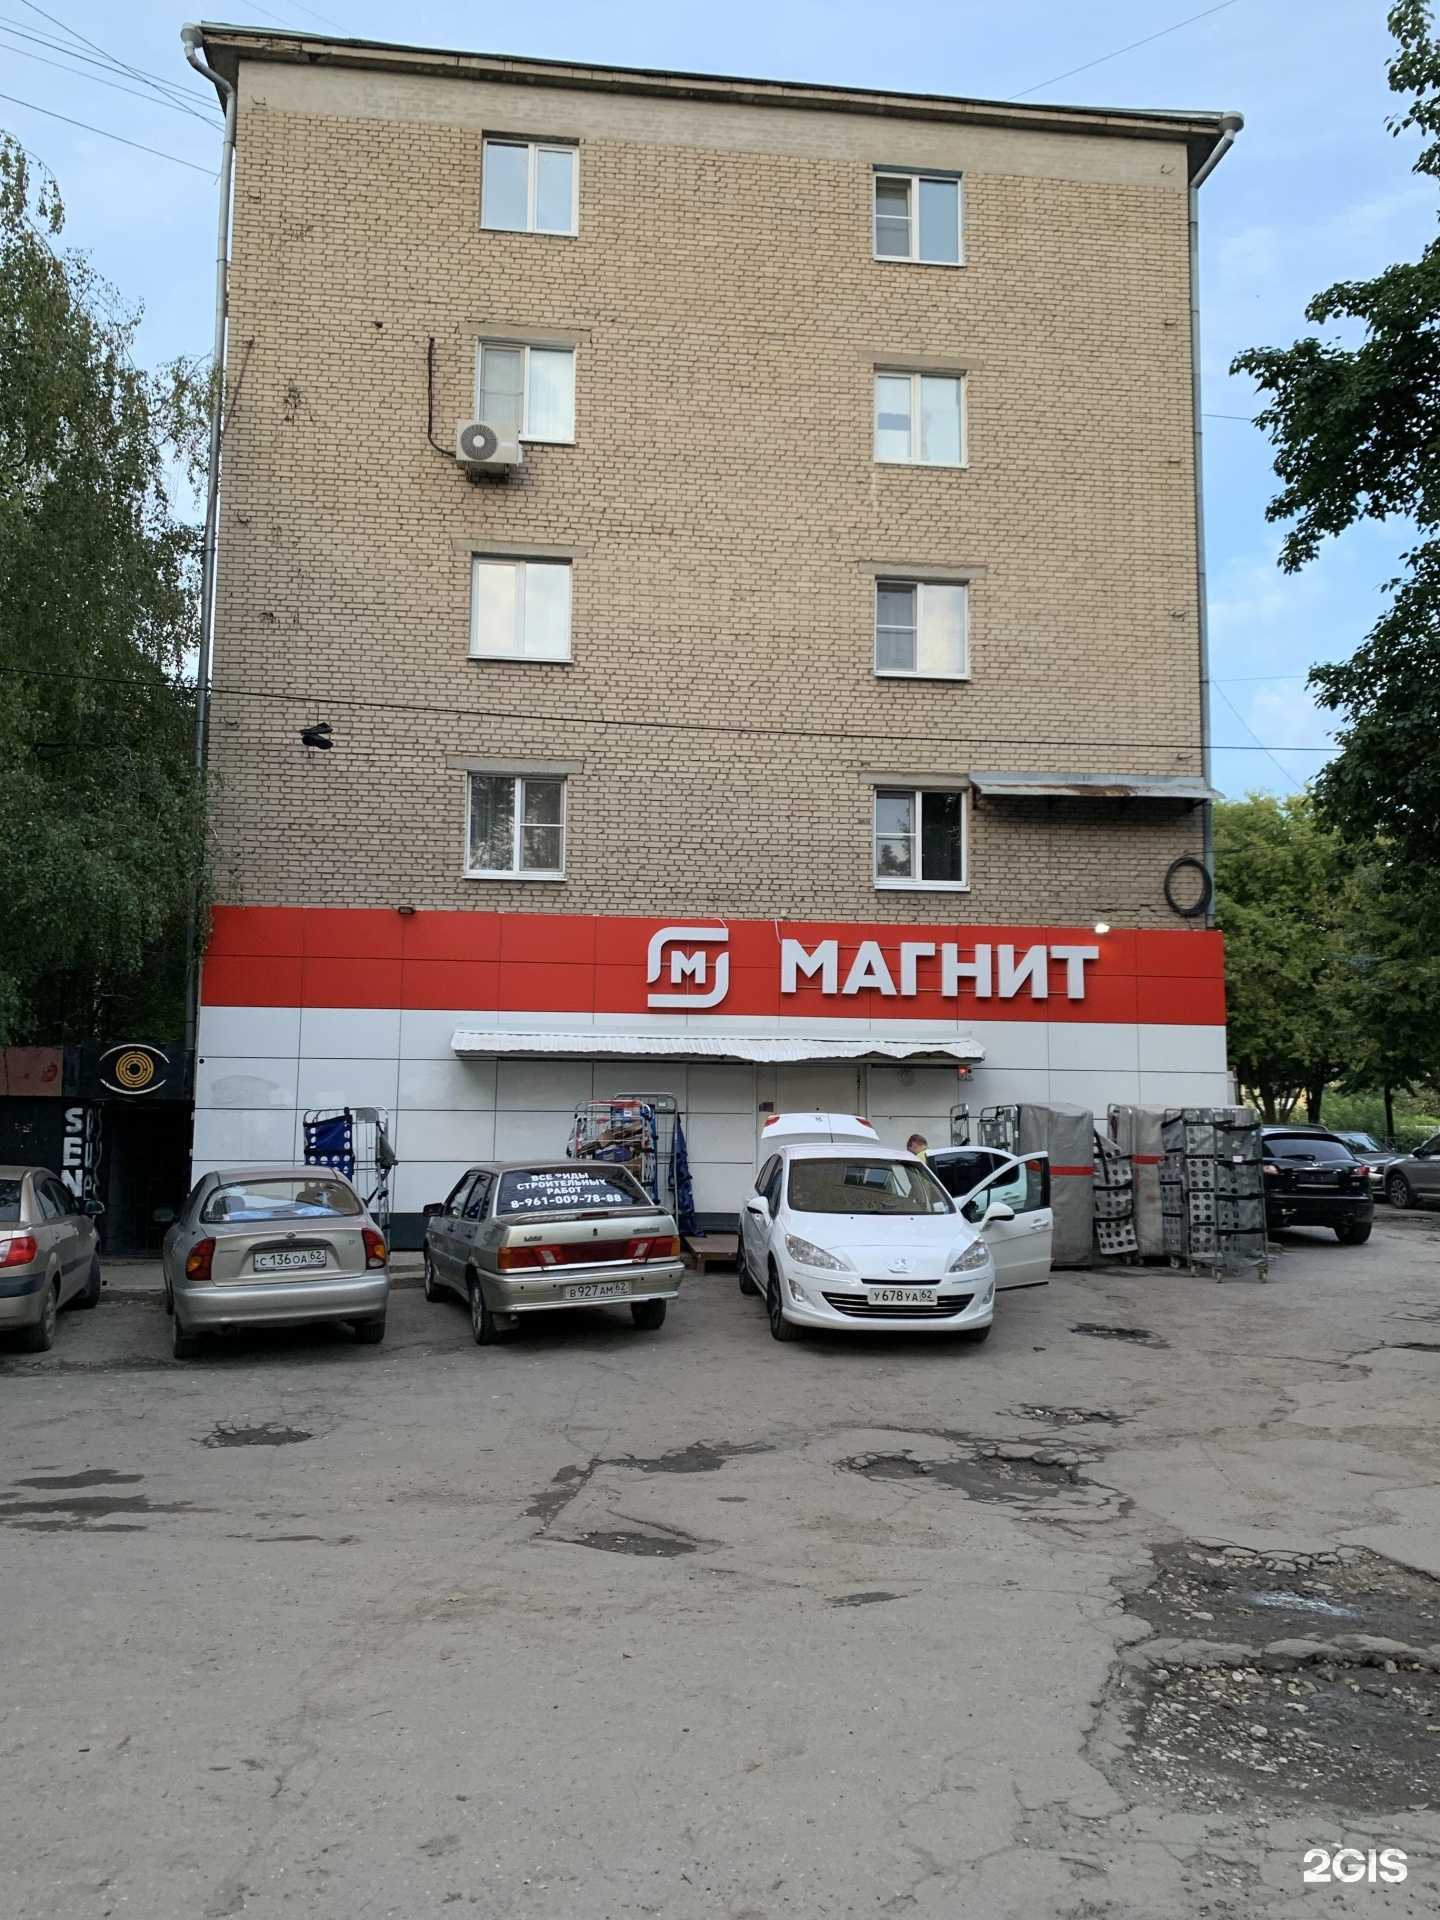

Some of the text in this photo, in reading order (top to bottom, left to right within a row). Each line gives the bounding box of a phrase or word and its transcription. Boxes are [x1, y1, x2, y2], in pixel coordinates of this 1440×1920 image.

[780, 938, 1100, 1000] МАГНИТ
[531, 1173, 553, 1182] ВСЕ
[516, 1178, 607, 1190] СТРОИТЕЛЬНЫХ
[546, 1187, 582, 1195] РАБОТ
[511, 1194, 623, 1208] 8-961-009-78-88
